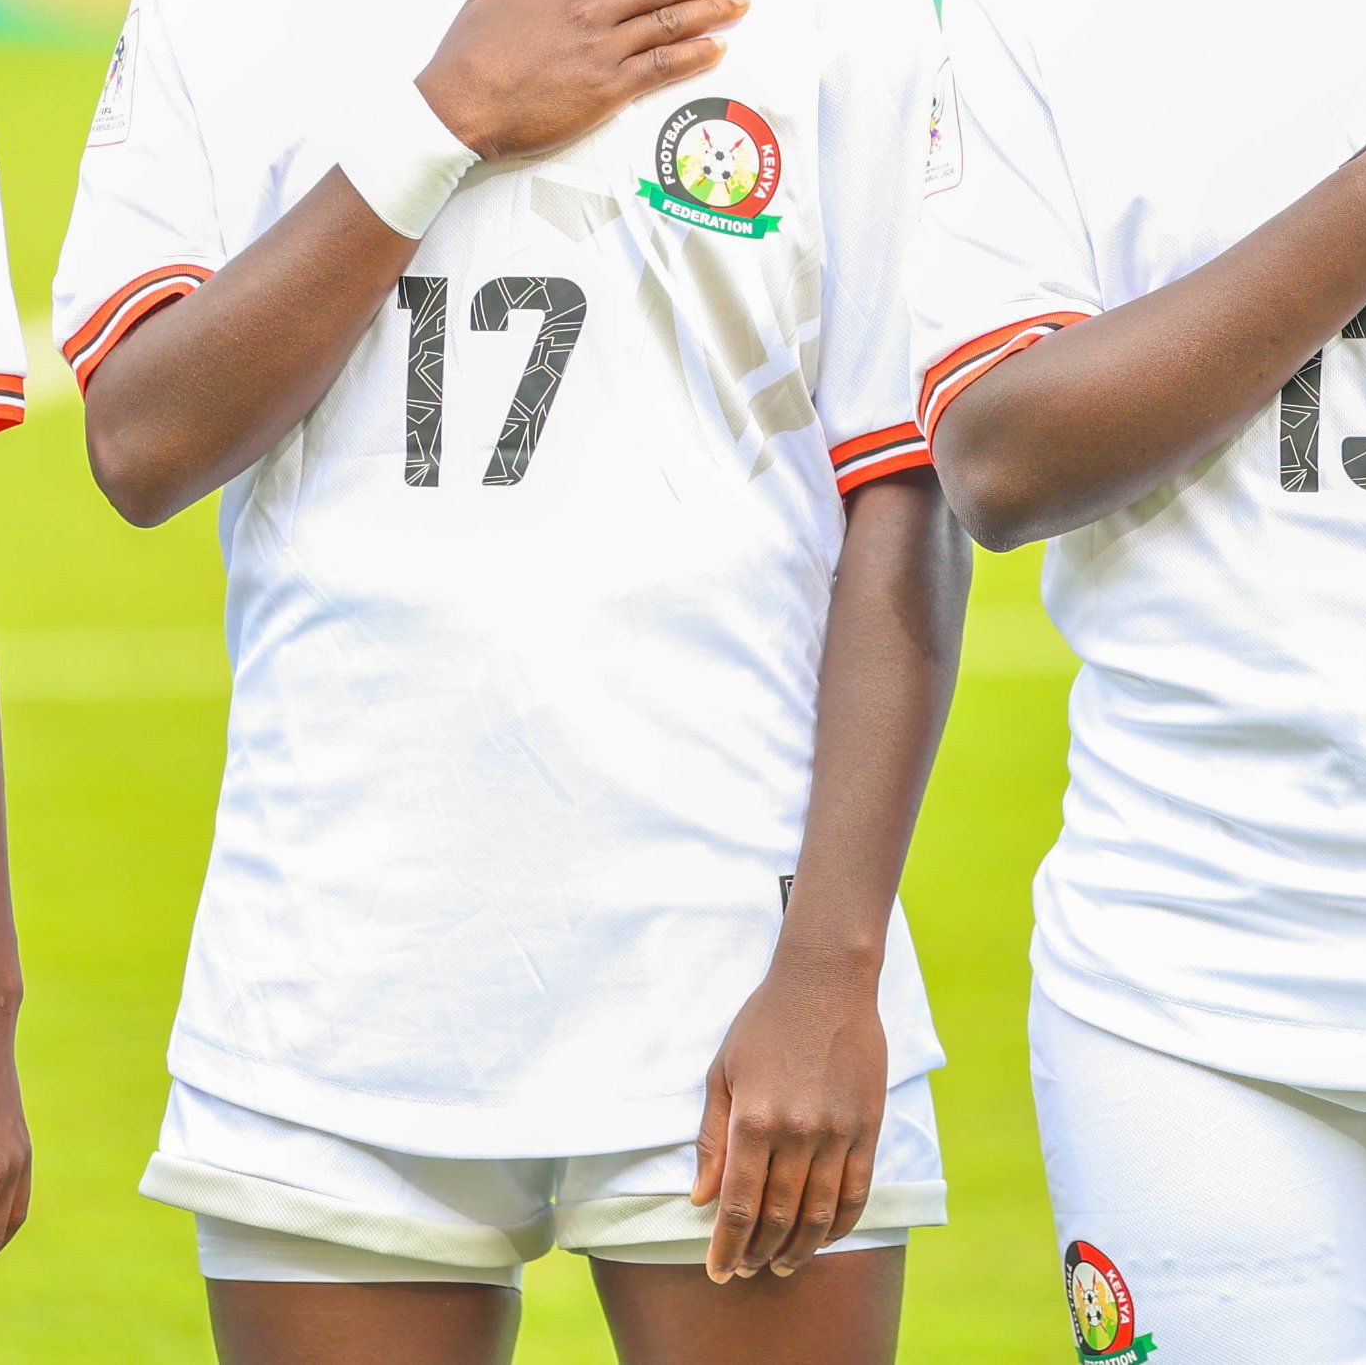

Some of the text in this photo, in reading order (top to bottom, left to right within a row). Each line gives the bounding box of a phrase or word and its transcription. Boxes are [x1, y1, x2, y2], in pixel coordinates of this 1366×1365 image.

[660, 109, 698, 185] FOOTBALL
[753, 143, 776, 200] KENYA
[662, 199, 753, 235] FEDERATION
[397, 276, 587, 487] 17
[1105, 1267, 1131, 1325] KENYA
